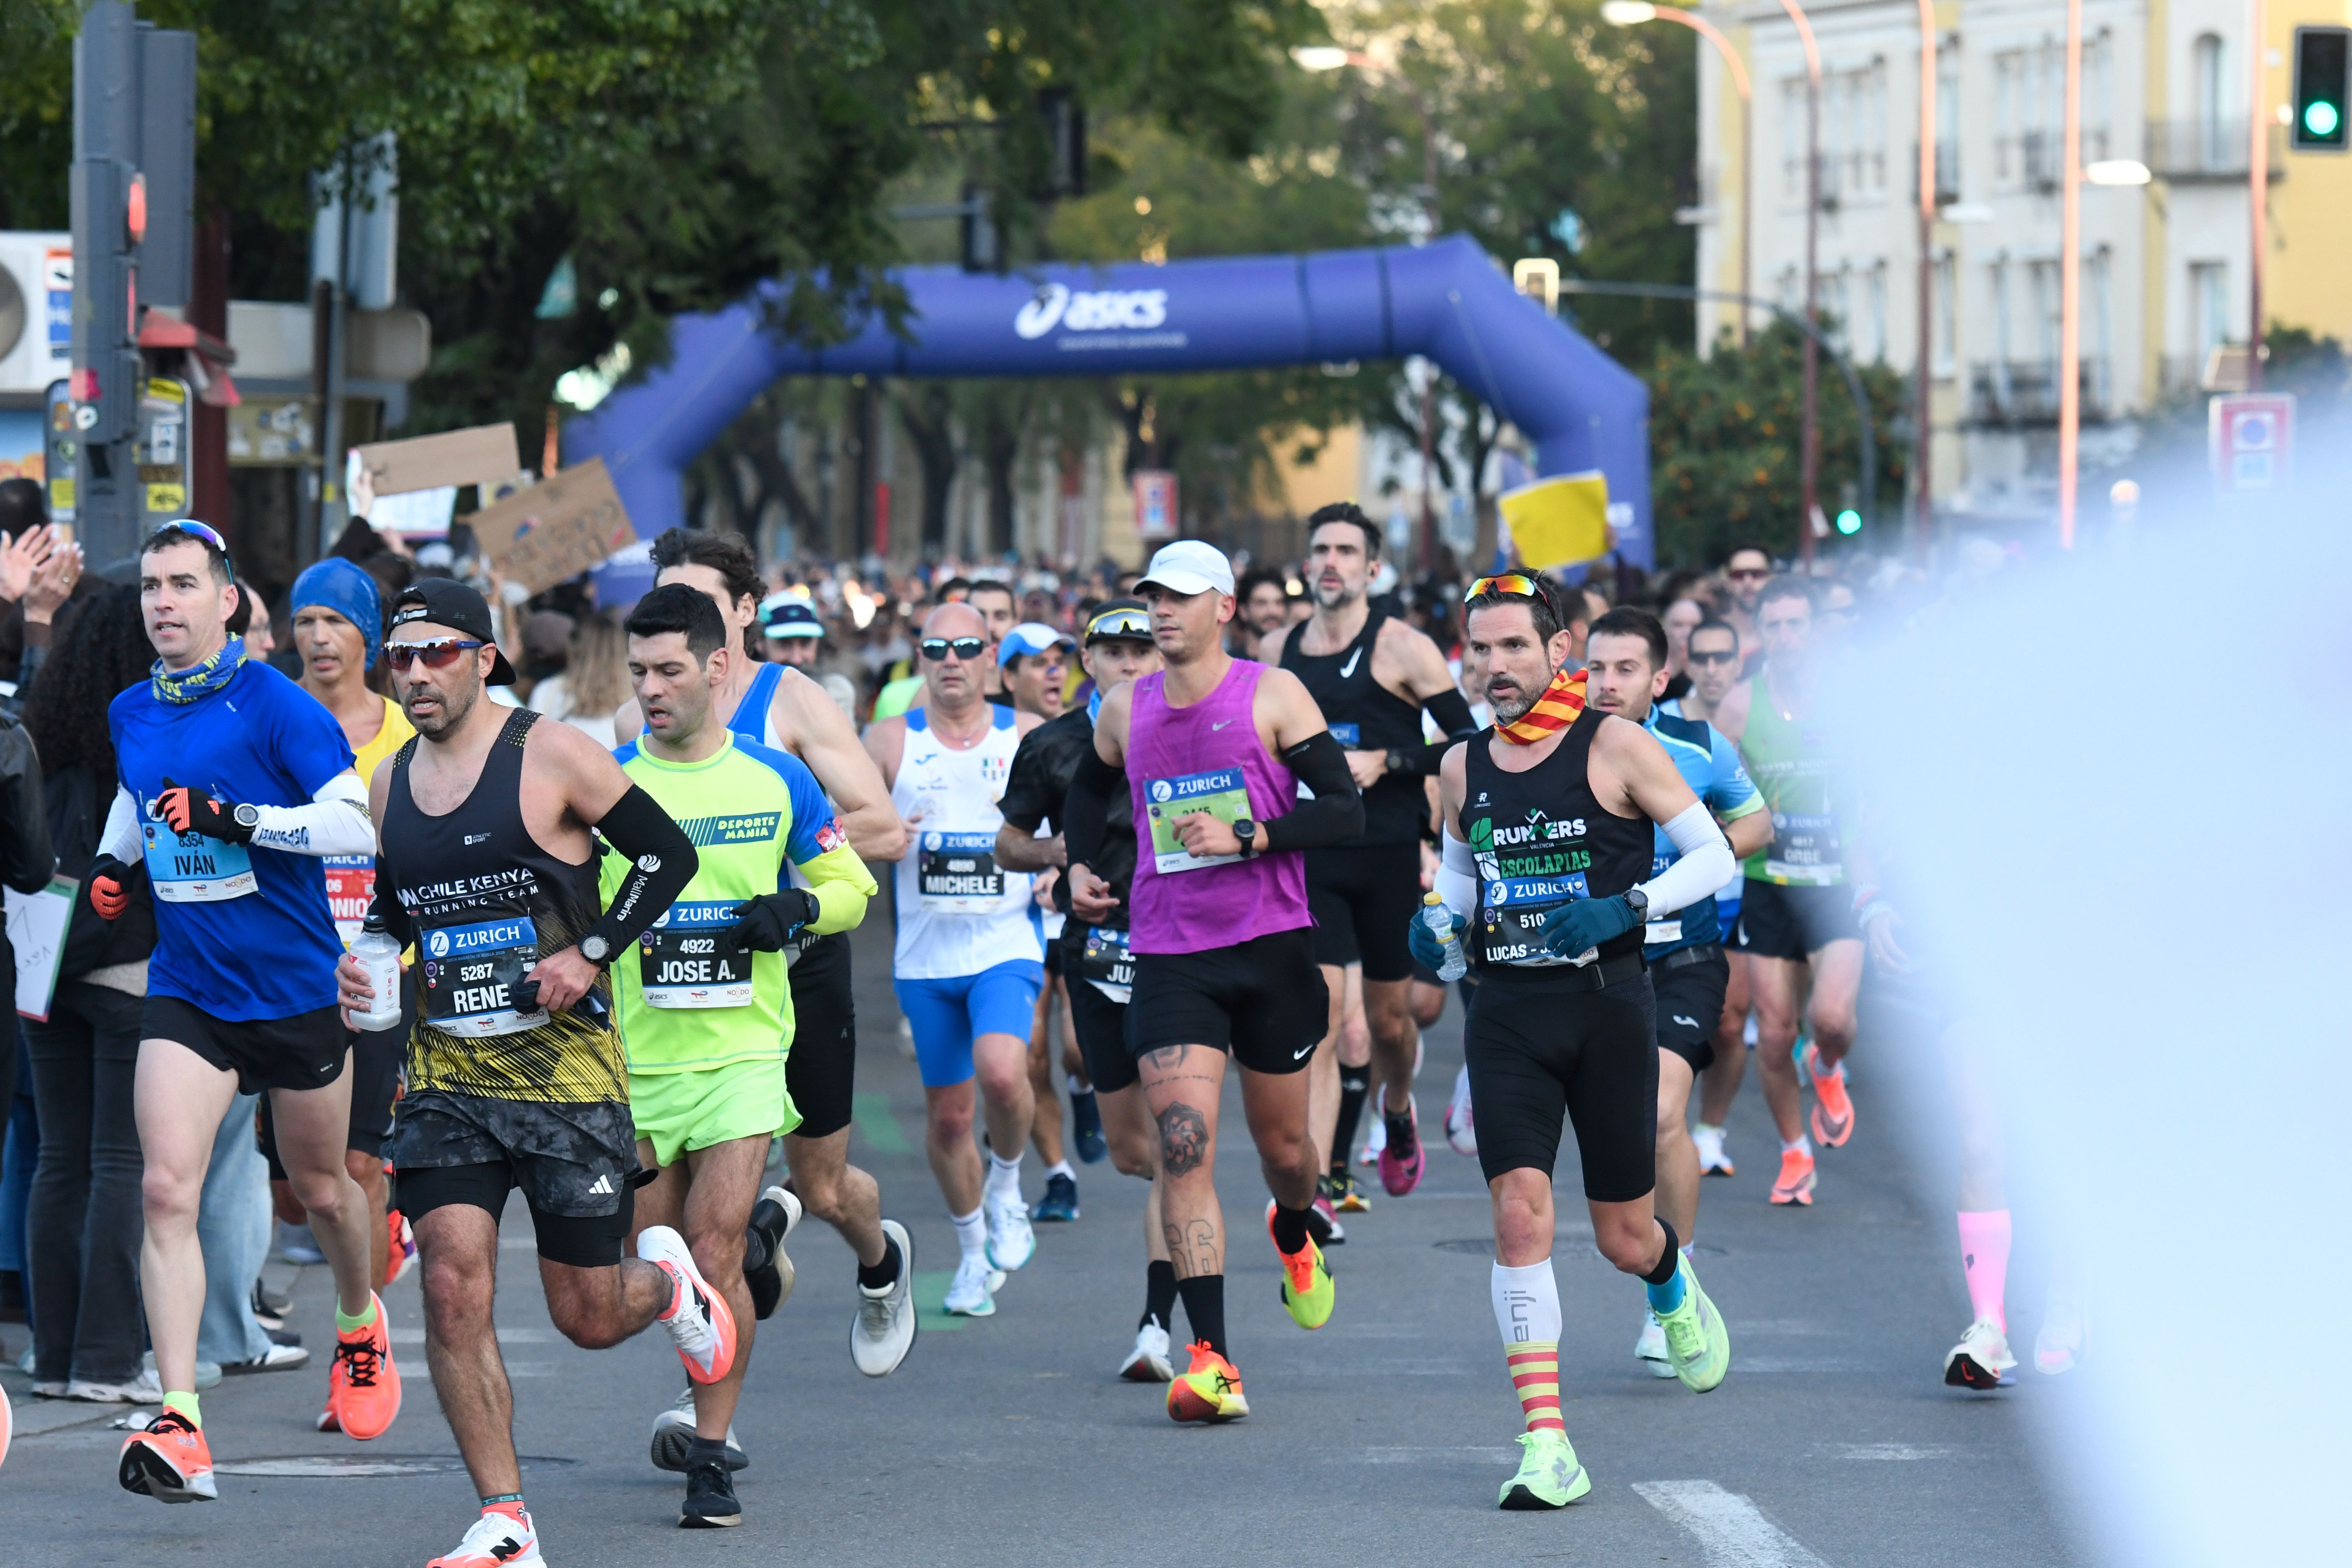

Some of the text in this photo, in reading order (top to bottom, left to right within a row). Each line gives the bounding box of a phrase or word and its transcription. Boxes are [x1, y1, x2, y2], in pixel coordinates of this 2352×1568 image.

[1177, 775, 1231, 795] ZURICH
[718, 816, 775, 830] DEPORTE
[178, 833, 204, 847] 8354
[724, 828, 768, 840] MANIA
[947, 836, 996, 848] ZURICH
[174, 850, 216, 876] IVÁN
[322, 855, 368, 865] URICH
[1500, 850, 1592, 879] ESCOLAPIAS
[418, 868, 534, 899] CHILE KENYA
[926, 875, 998, 894] MICHELE
[1514, 882, 1573, 898] ZURICH
[424, 885, 539, 916] RUNNING TEAM
[677, 906, 740, 921] ZURICH
[1520, 913, 1546, 928] 510
[455, 926, 520, 948] ZURICH
[680, 939, 715, 954] 4922
[1486, 944, 1527, 961] LUCAS
[460, 963, 493, 982] 5287
[656, 959, 735, 983] JOSE A.
[453, 984, 511, 1013] RENE
[1504, 1290, 1536, 1342] enji
